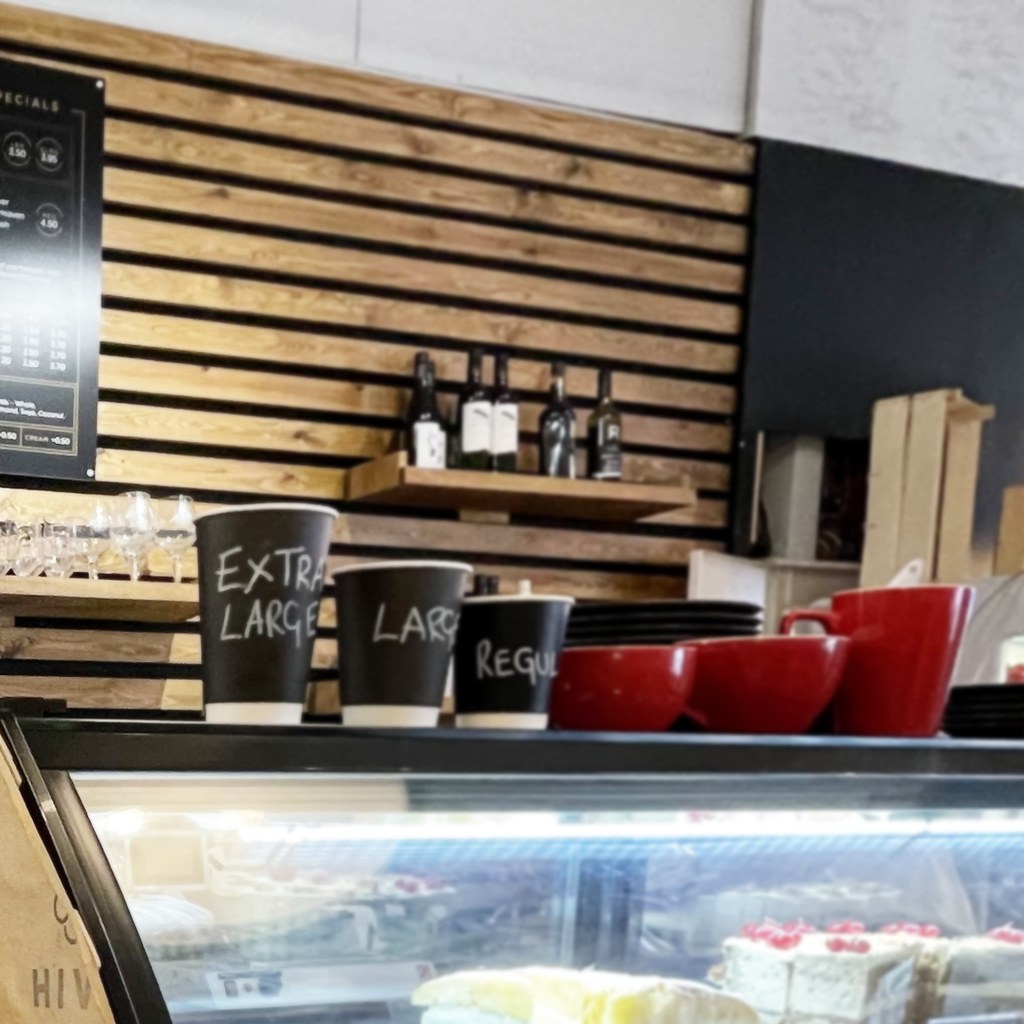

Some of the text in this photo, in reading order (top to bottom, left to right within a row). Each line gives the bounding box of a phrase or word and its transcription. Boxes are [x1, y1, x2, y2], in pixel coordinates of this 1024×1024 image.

[219, 599, 317, 647] LARGE
[372, 604, 460, 651] LARG
[476, 639, 558, 686] REGUL
[32, 968, 93, 1010] HIV
